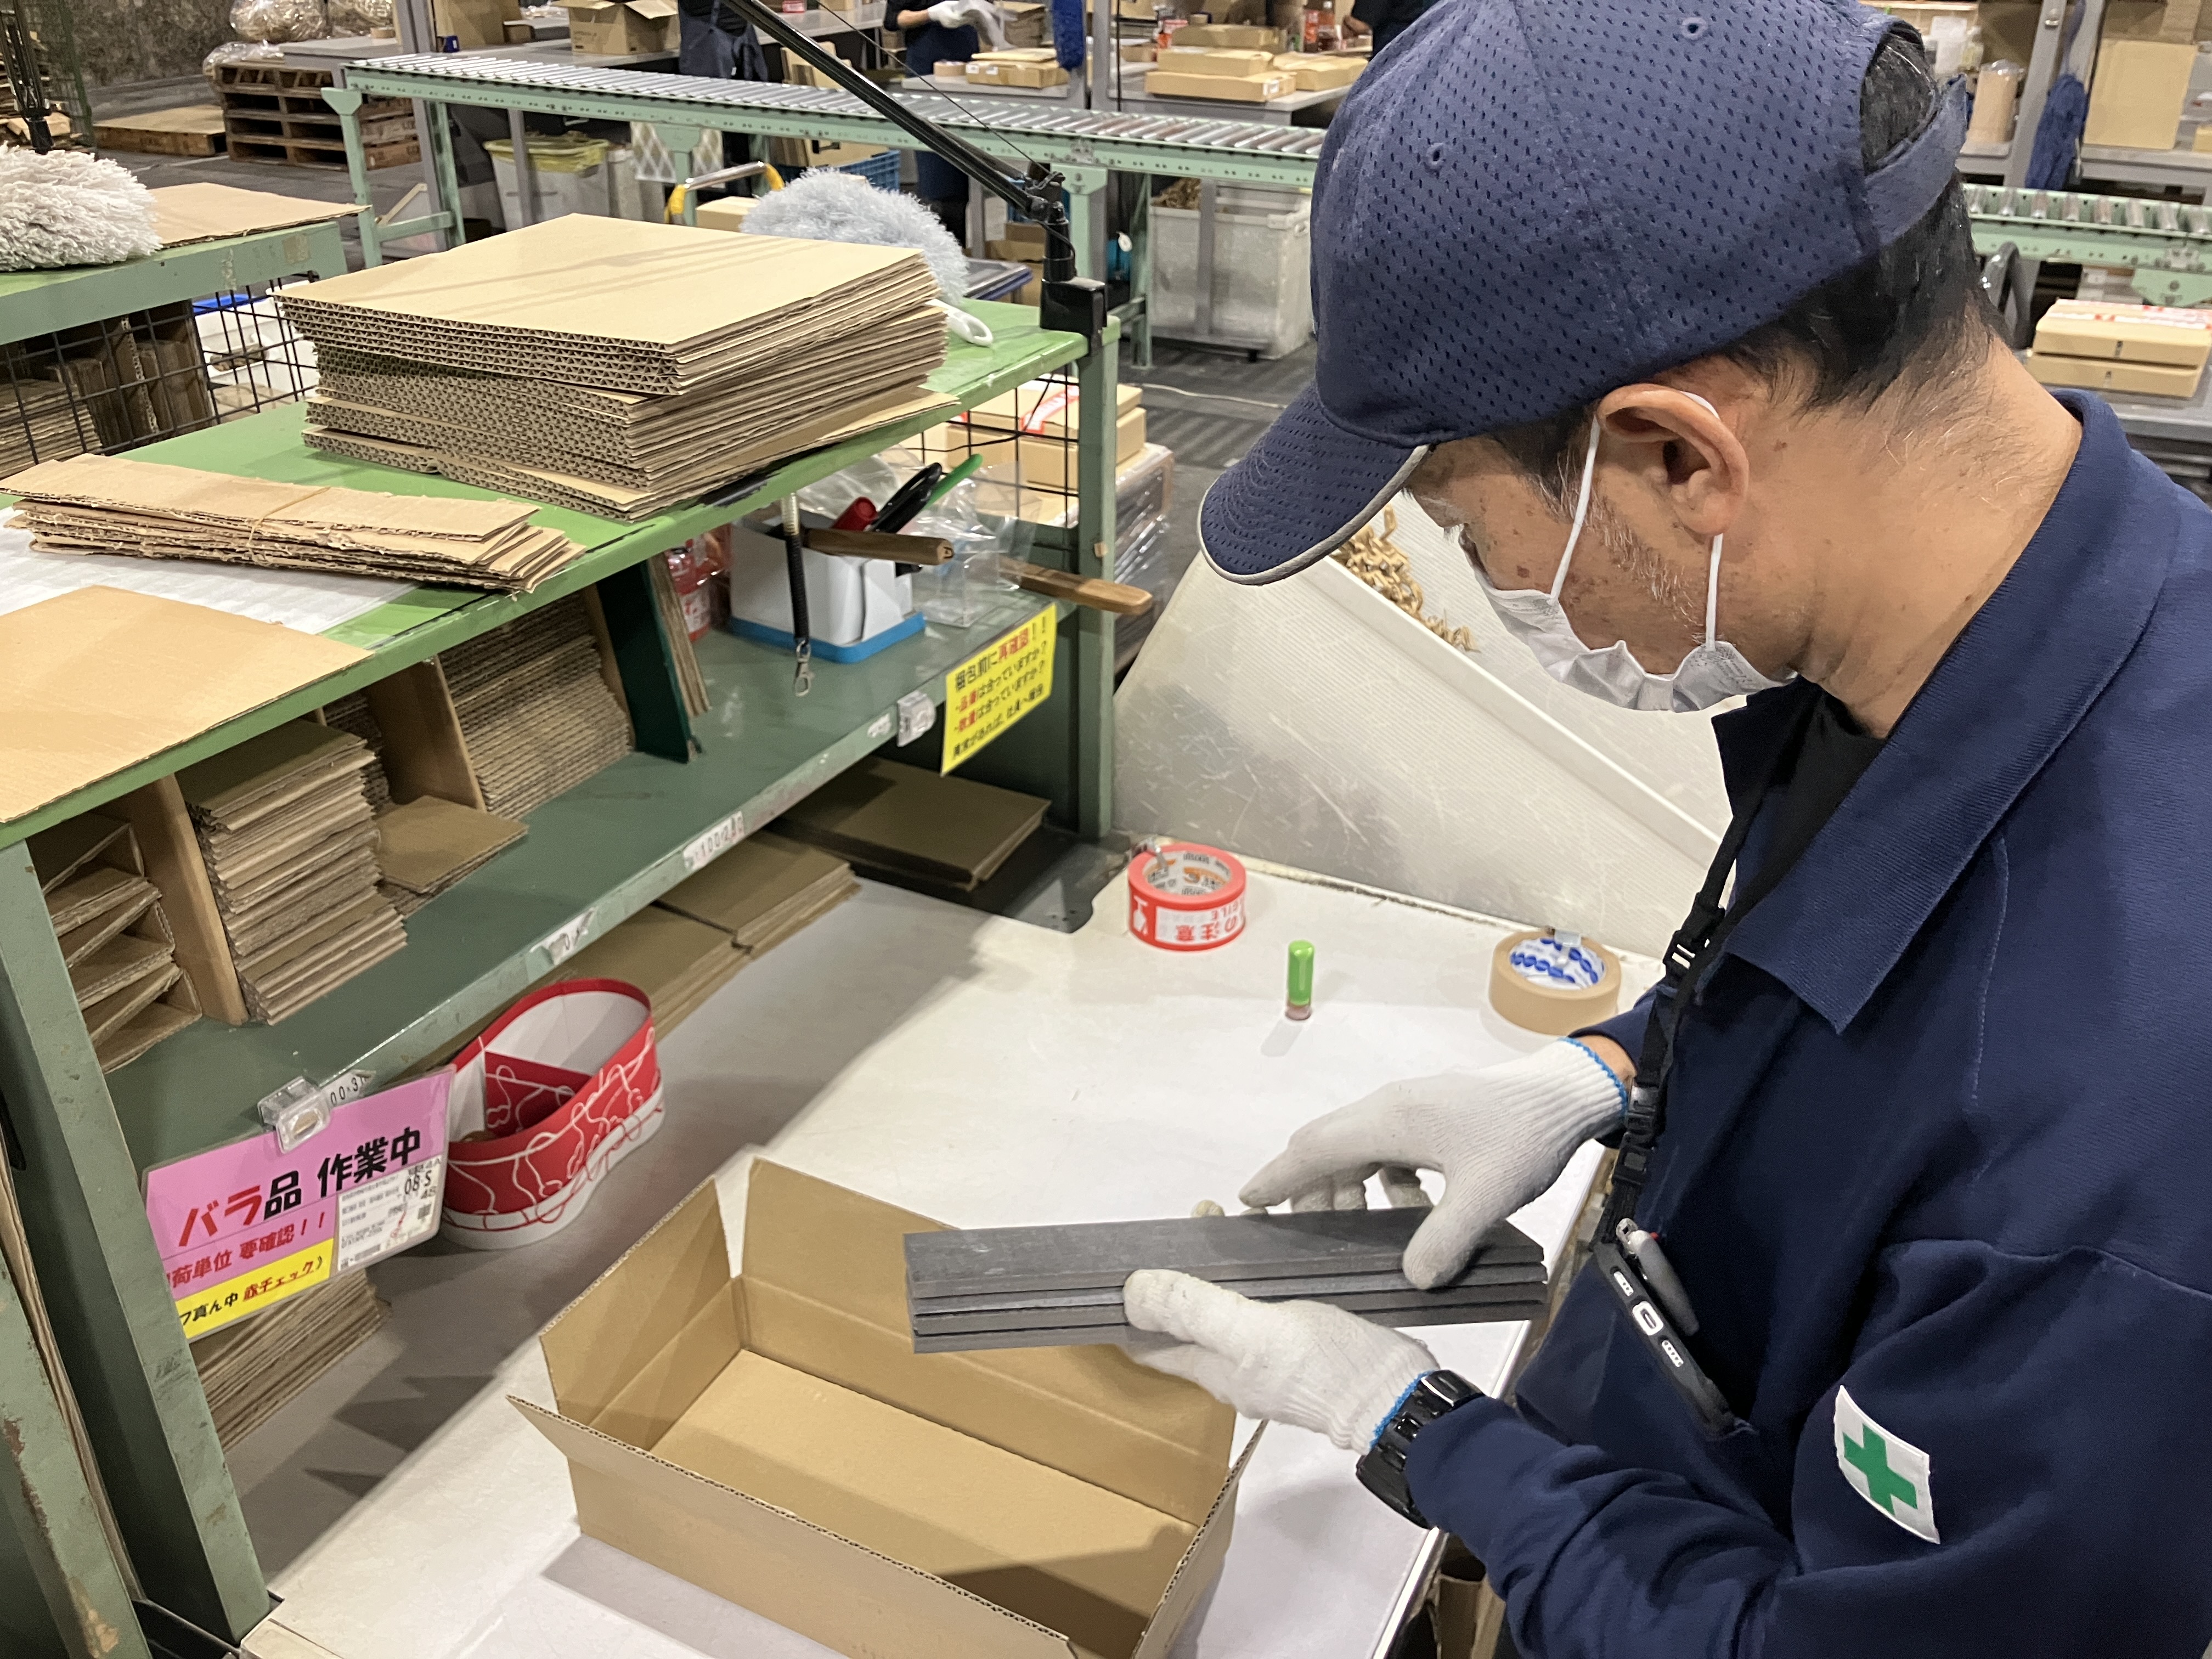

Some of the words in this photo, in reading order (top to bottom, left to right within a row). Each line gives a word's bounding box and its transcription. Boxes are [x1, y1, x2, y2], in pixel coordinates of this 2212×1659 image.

[179, 1170, 301, 1246] バラ品
[317, 1127, 421, 1198] 作業中
[166, 1250, 233, 1288] 荷単位
